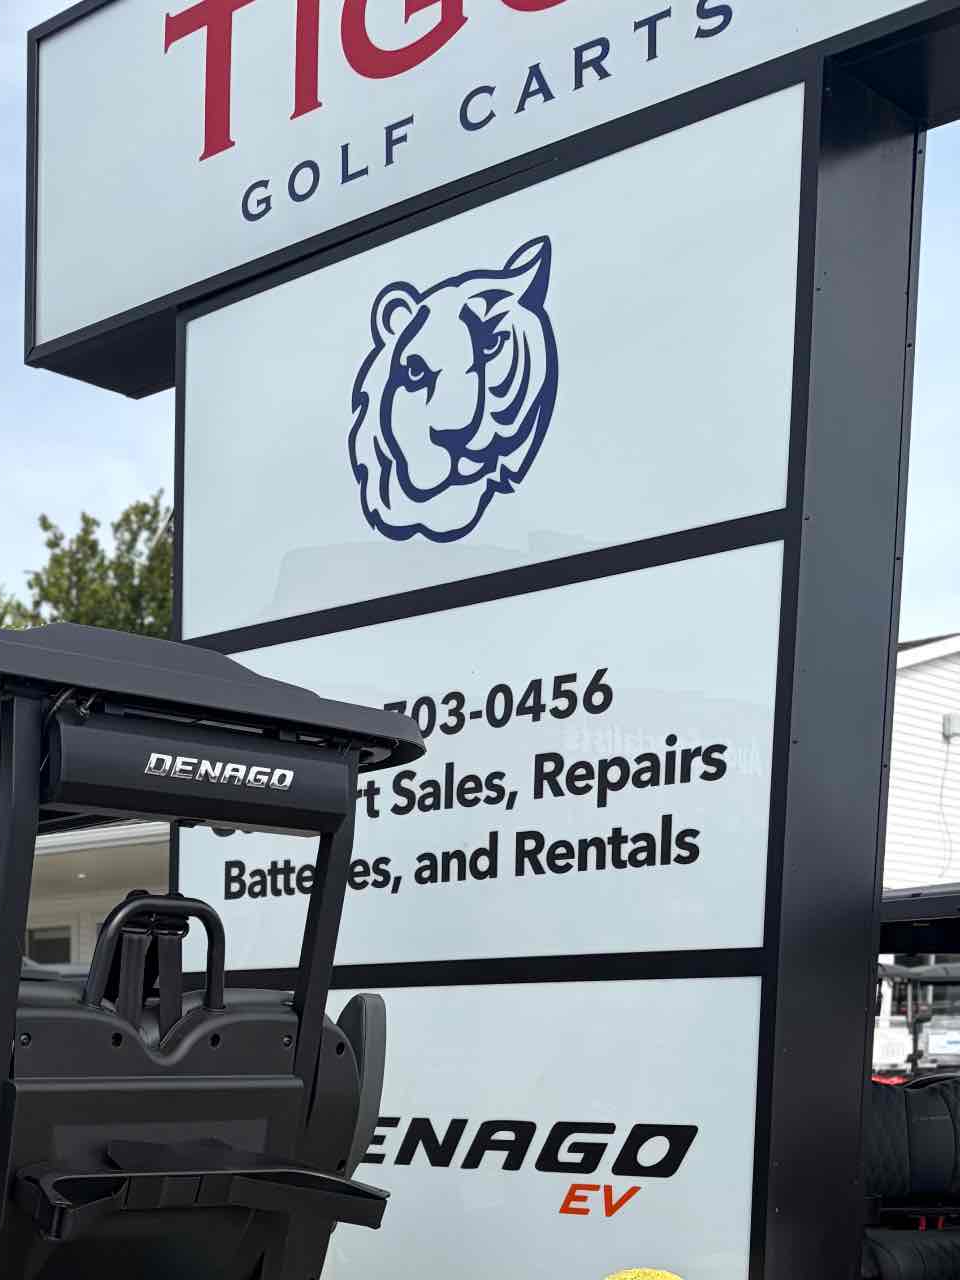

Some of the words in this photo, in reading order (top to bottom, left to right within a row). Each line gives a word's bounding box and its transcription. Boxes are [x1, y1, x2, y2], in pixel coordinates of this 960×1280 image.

[165, 0, 567, 161] TIG
[241, 113, 414, 222] GOLF
[459, 0, 733, 131] CARTS
[144, 752, 295, 791] DENAGO
[390, 761, 519, 816] Sales,
[533, 733, 728, 809] Repairs
[223, 856, 403, 901] Battees,
[414, 830, 499, 885] and
[514, 813, 701, 877] Rentals
[361, 1116, 699, 1179] ENAGO
[558, 1183, 642, 1218] EV
